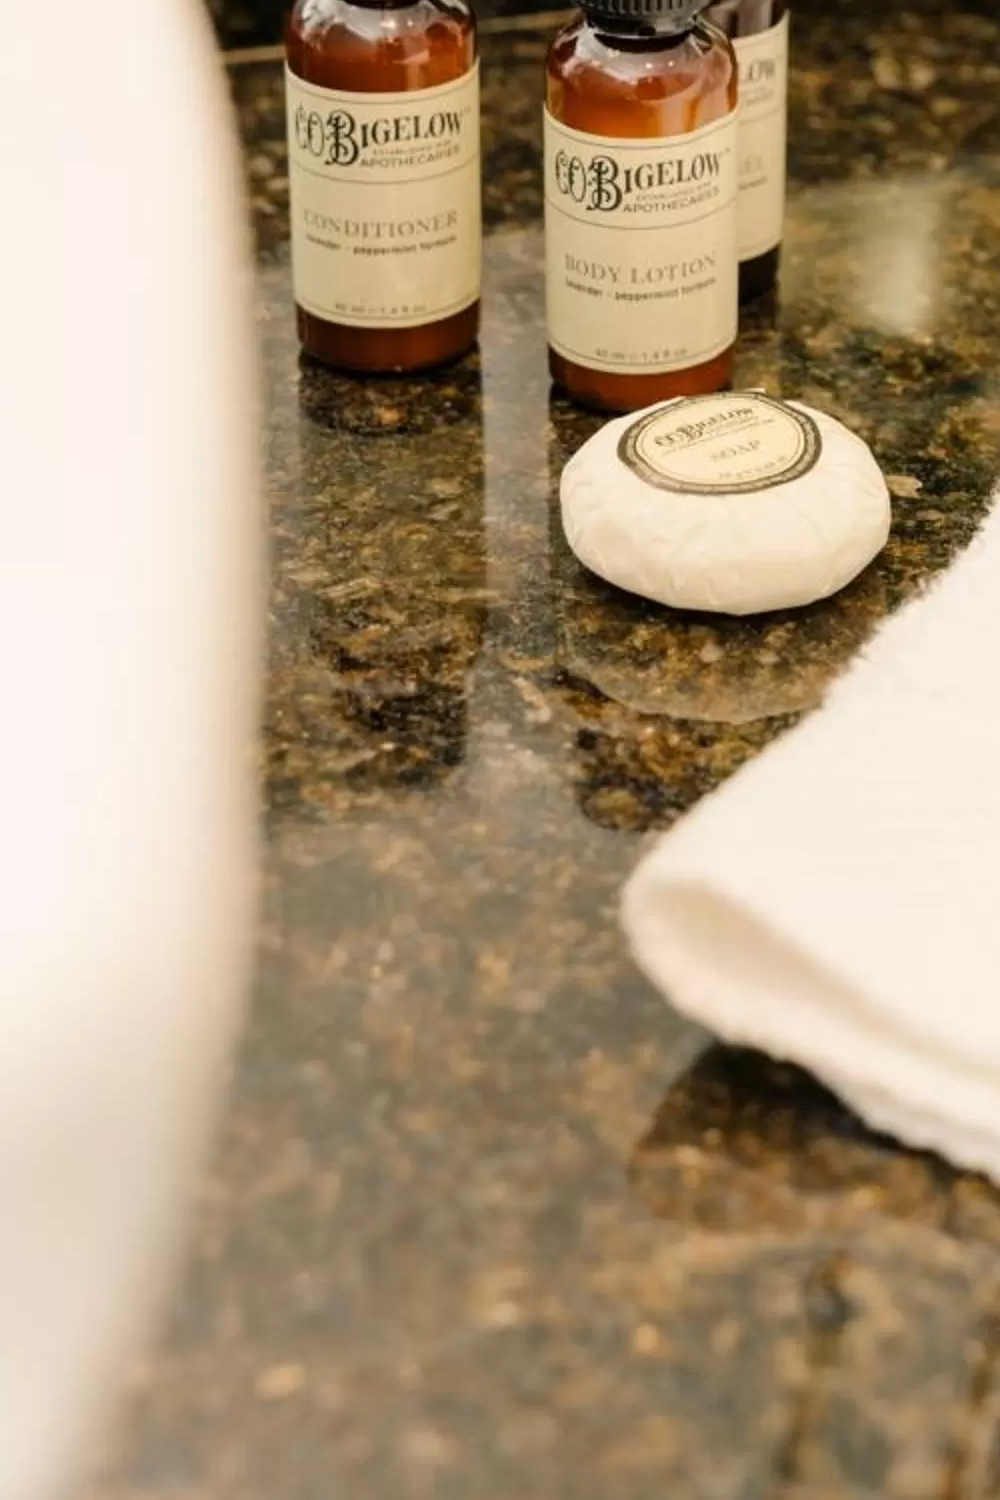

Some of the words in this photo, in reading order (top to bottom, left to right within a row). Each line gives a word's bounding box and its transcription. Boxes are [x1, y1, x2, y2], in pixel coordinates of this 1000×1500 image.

[621, 186, 721, 213] APOTHECARIES
[303, 207, 459, 239] CONDITIONER
[563, 252, 622, 284] BODY
[629, 250, 718, 285] LOTION
